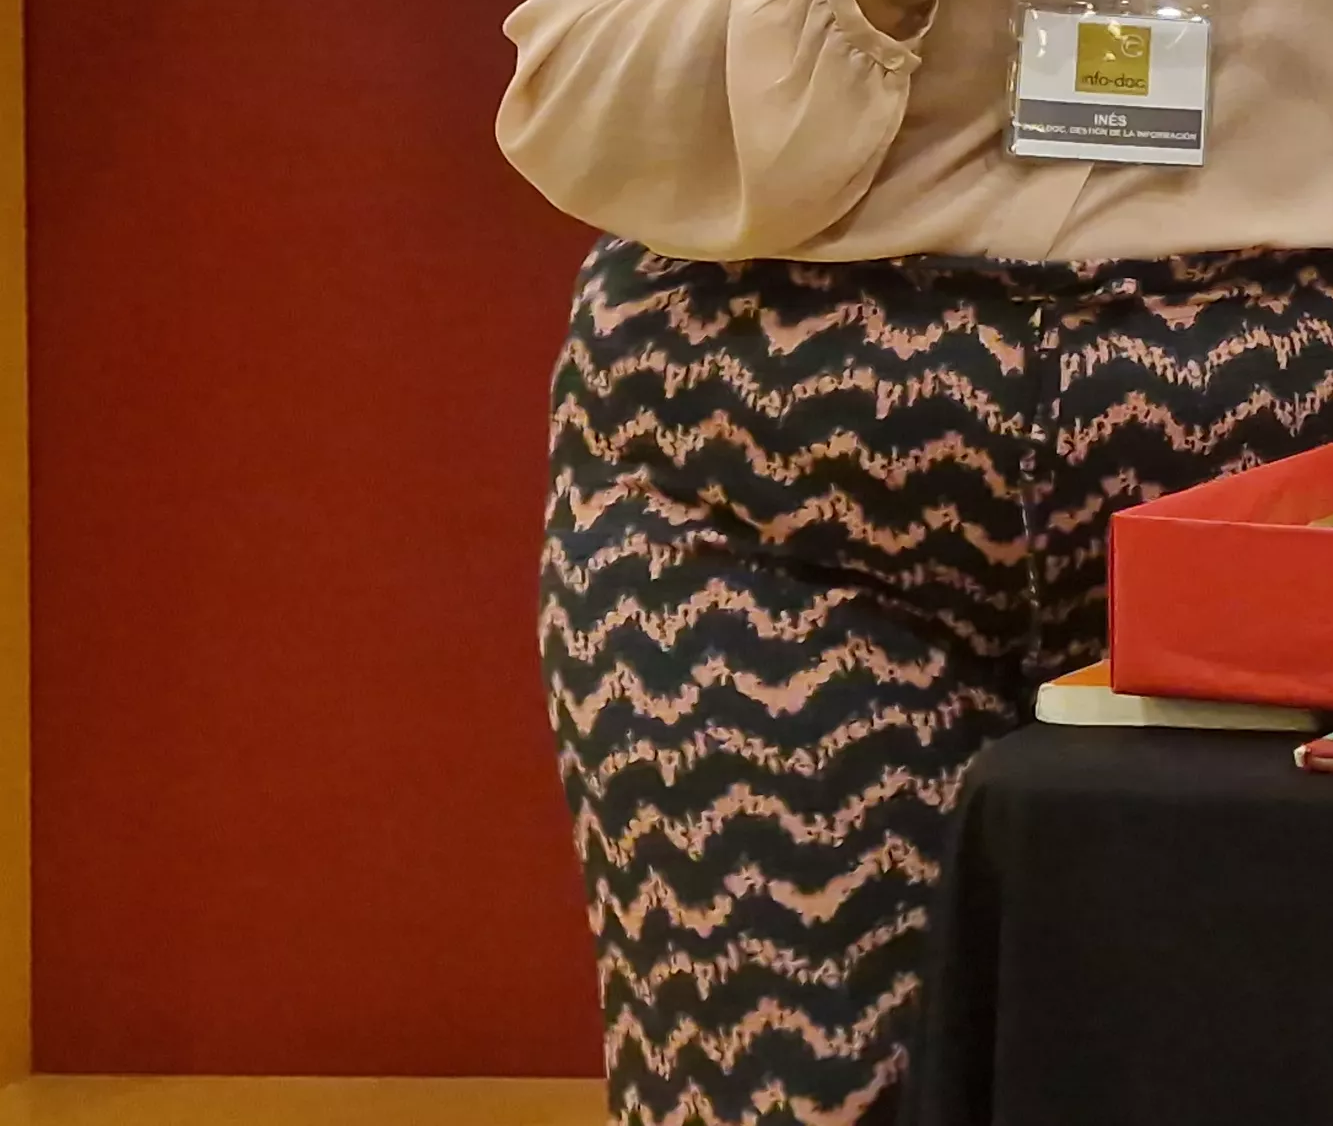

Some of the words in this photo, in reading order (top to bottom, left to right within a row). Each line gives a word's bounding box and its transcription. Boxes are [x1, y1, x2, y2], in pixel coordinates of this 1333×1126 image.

[1081, 71, 1147, 89] info-doc
[1094, 111, 1128, 127] INÉS
[1123, 130, 1135, 139] LA
